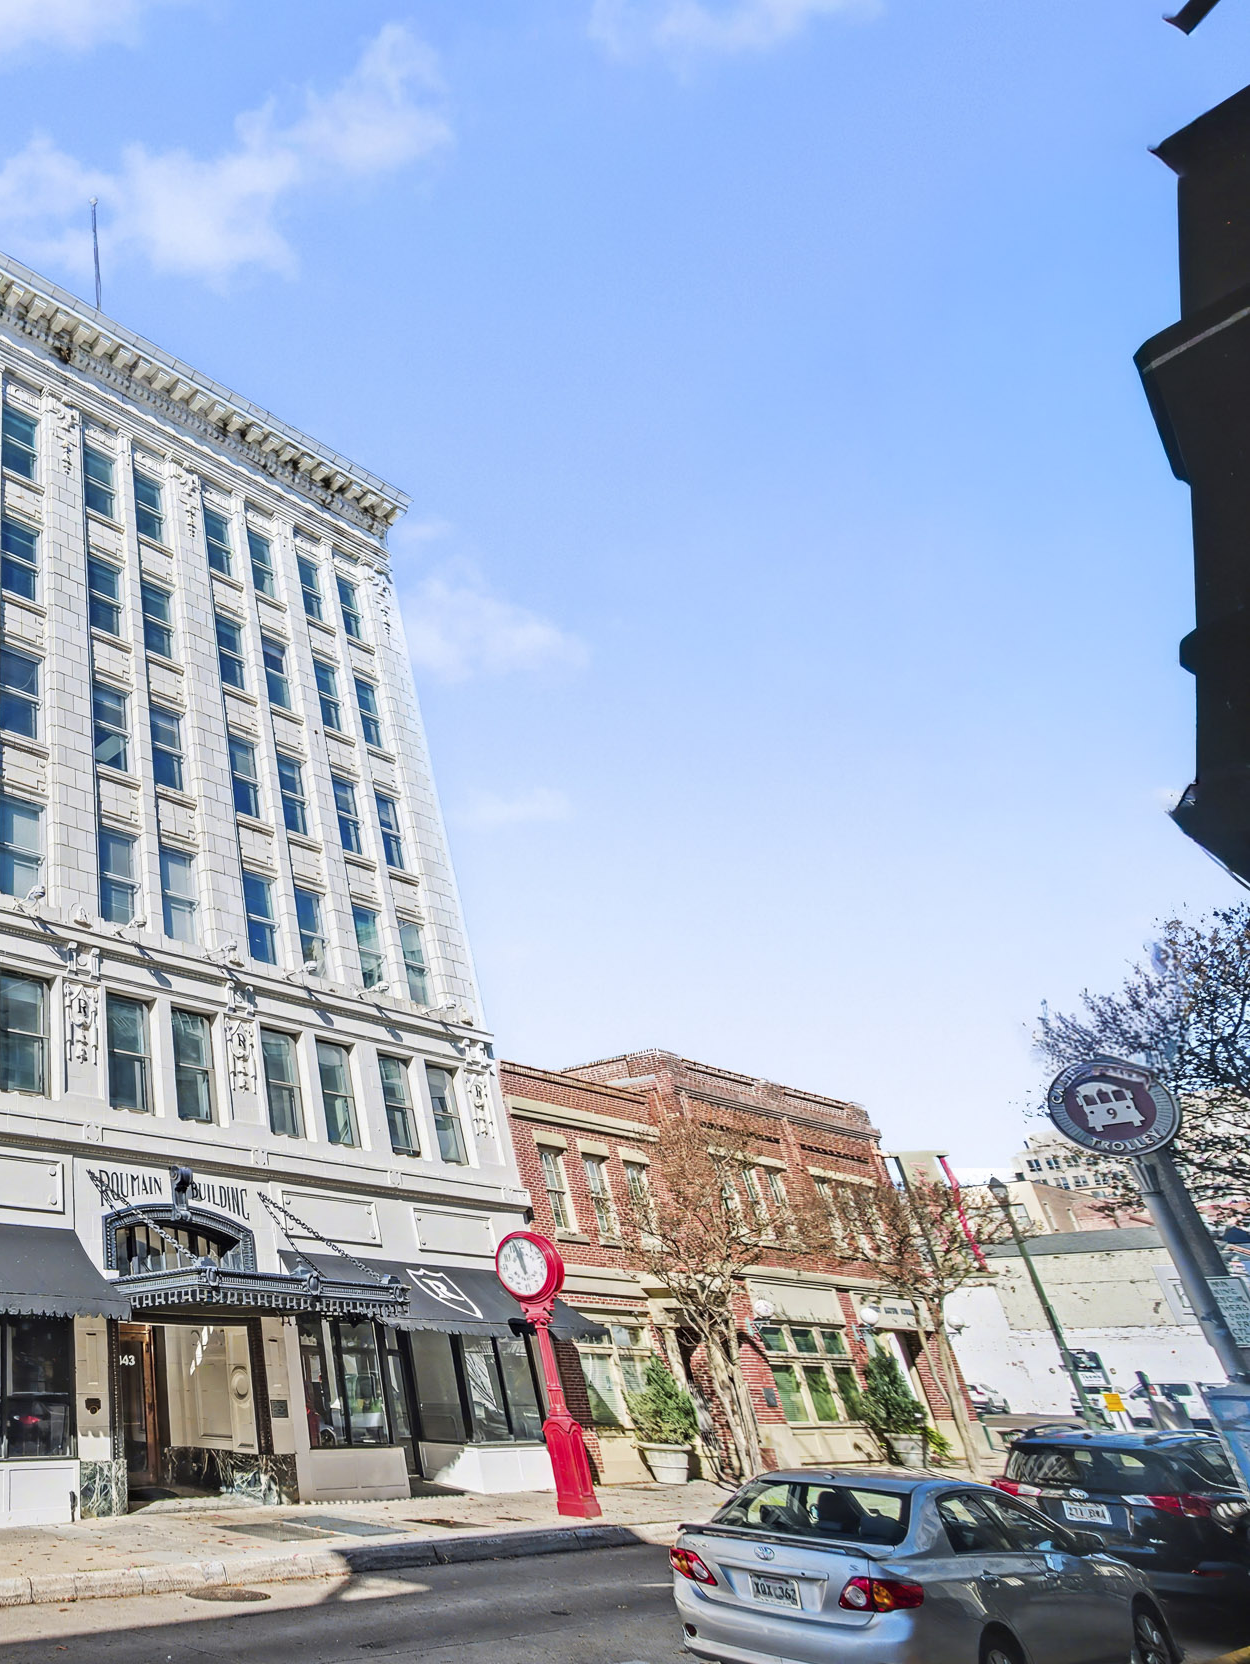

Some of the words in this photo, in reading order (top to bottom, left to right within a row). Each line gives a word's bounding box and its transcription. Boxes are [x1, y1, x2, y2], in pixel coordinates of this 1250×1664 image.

[77, 998, 89, 1018] R
[1106, 1107, 1119, 1120] 9
[1090, 1128, 1163, 1151] TROLLEY
[98, 1169, 162, 1207] ROUMAIN
[190, 1180, 251, 1222] BUILDING
[421, 1278, 465, 1301] R
